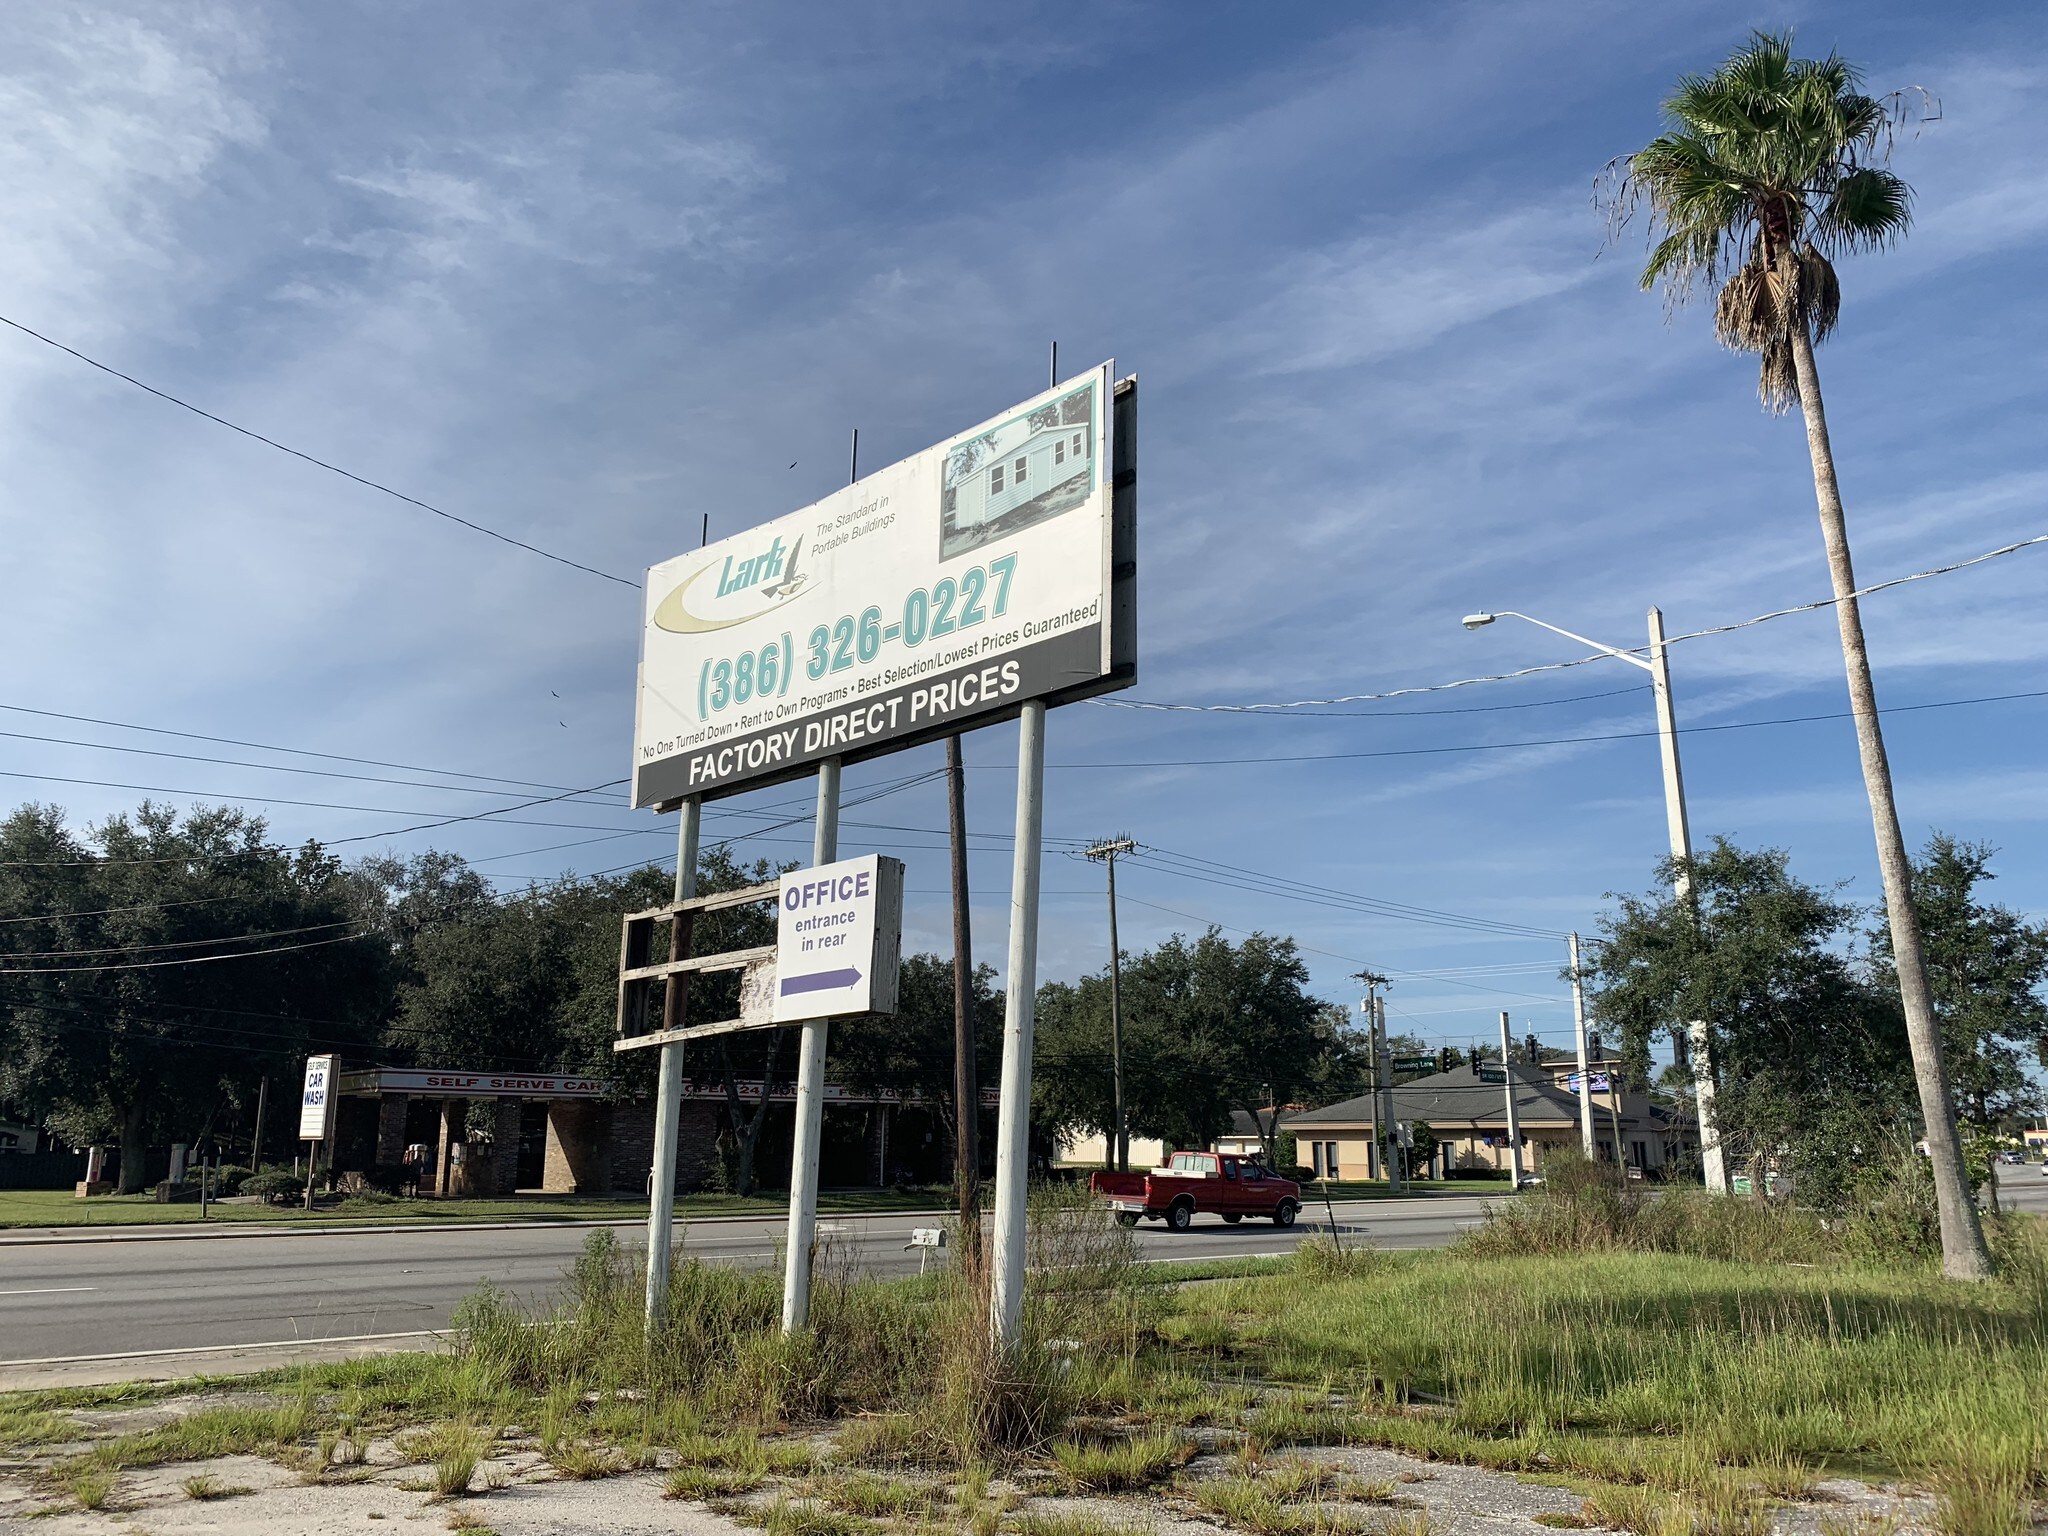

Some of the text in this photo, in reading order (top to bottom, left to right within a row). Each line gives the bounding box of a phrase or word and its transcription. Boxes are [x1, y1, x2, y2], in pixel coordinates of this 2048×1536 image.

[812, 512, 895, 557] Portable Buildings
[817, 496, 889, 537] The Standard in
[715, 535, 787, 600] Lark
[698, 551, 1018, 722] (386) 326-0227
[643, 599, 1098, 759] No One Turned Down Rent to Own Programs Best Selection/Lowest Prices Guaranteed
[689, 660, 1020, 786] FACTORY DIRECT PRICES
[785, 871, 870, 911] OFFICE
[795, 911, 856, 932] entrance
[801, 933, 847, 951] in rear
[304, 1090, 324, 1105] WASH
[309, 1072, 323, 1087] CAR
[426, 1077, 479, 1087] SELF
[490, 1079, 556, 1089] SERVE
[563, 1081, 601, 1091] CAR
[739, 1086, 760, 1094] 24
